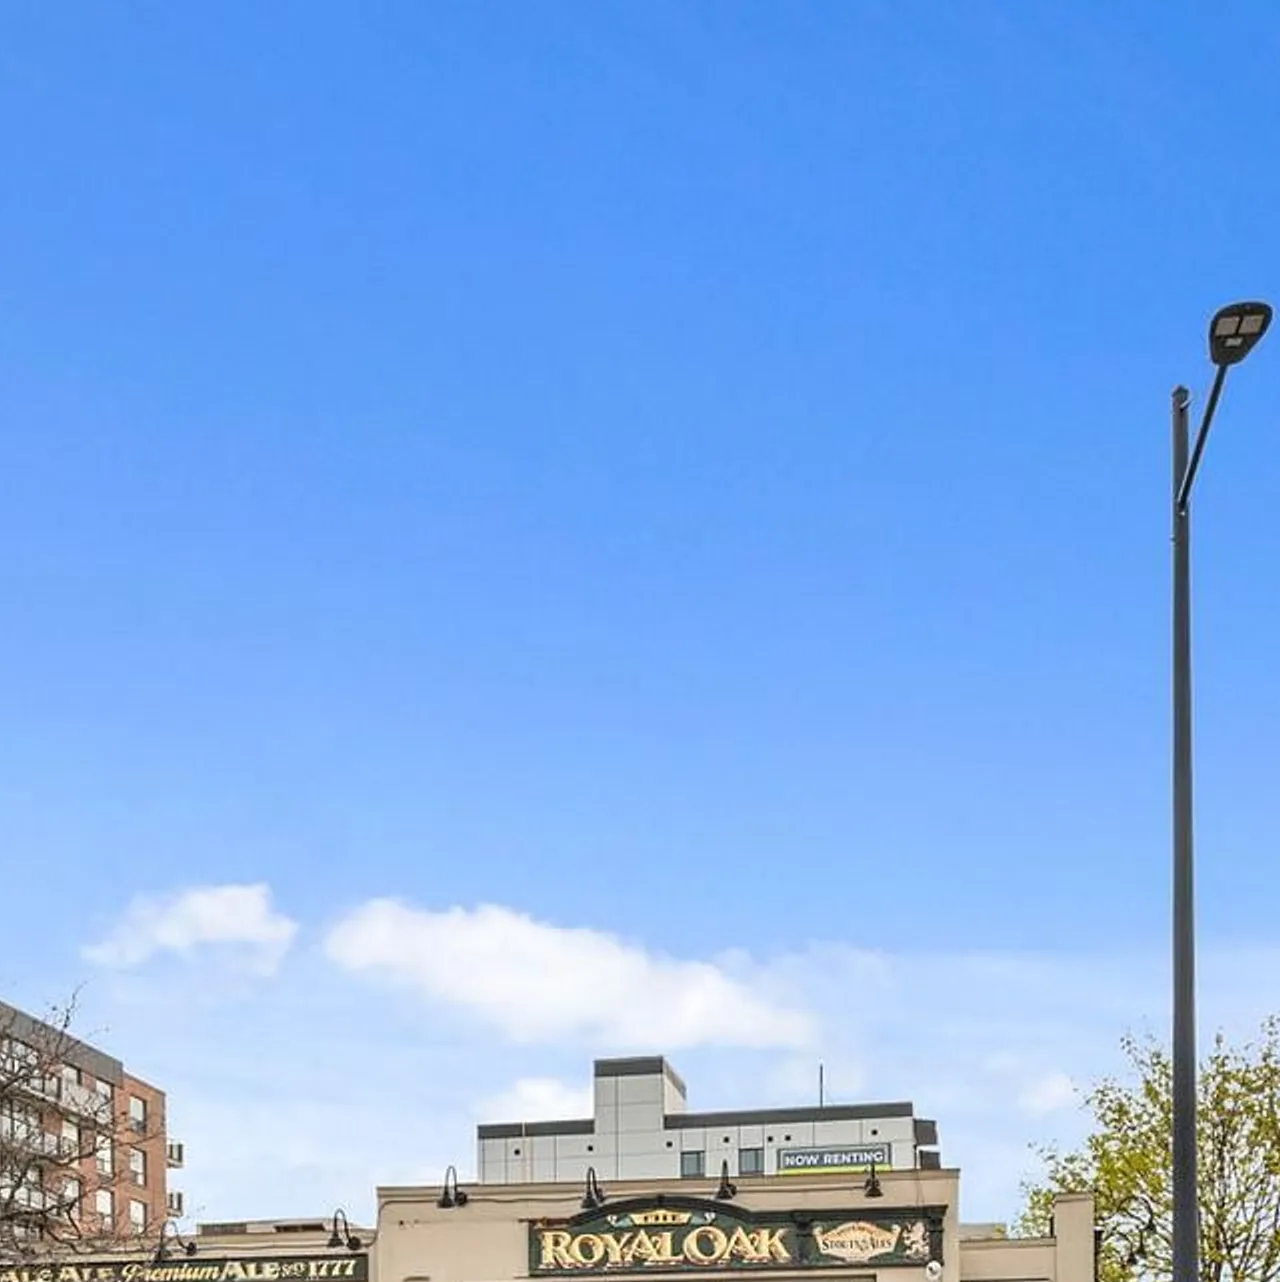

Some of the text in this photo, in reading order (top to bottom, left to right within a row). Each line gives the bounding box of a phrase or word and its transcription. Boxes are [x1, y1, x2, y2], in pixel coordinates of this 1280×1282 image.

[785, 1152, 883, 1166] NOW RENTING
[121, 1264, 221, 1282] Premium
[221, 1261, 280, 1281] ALE
[308, 1259, 356, 1277] 1777
